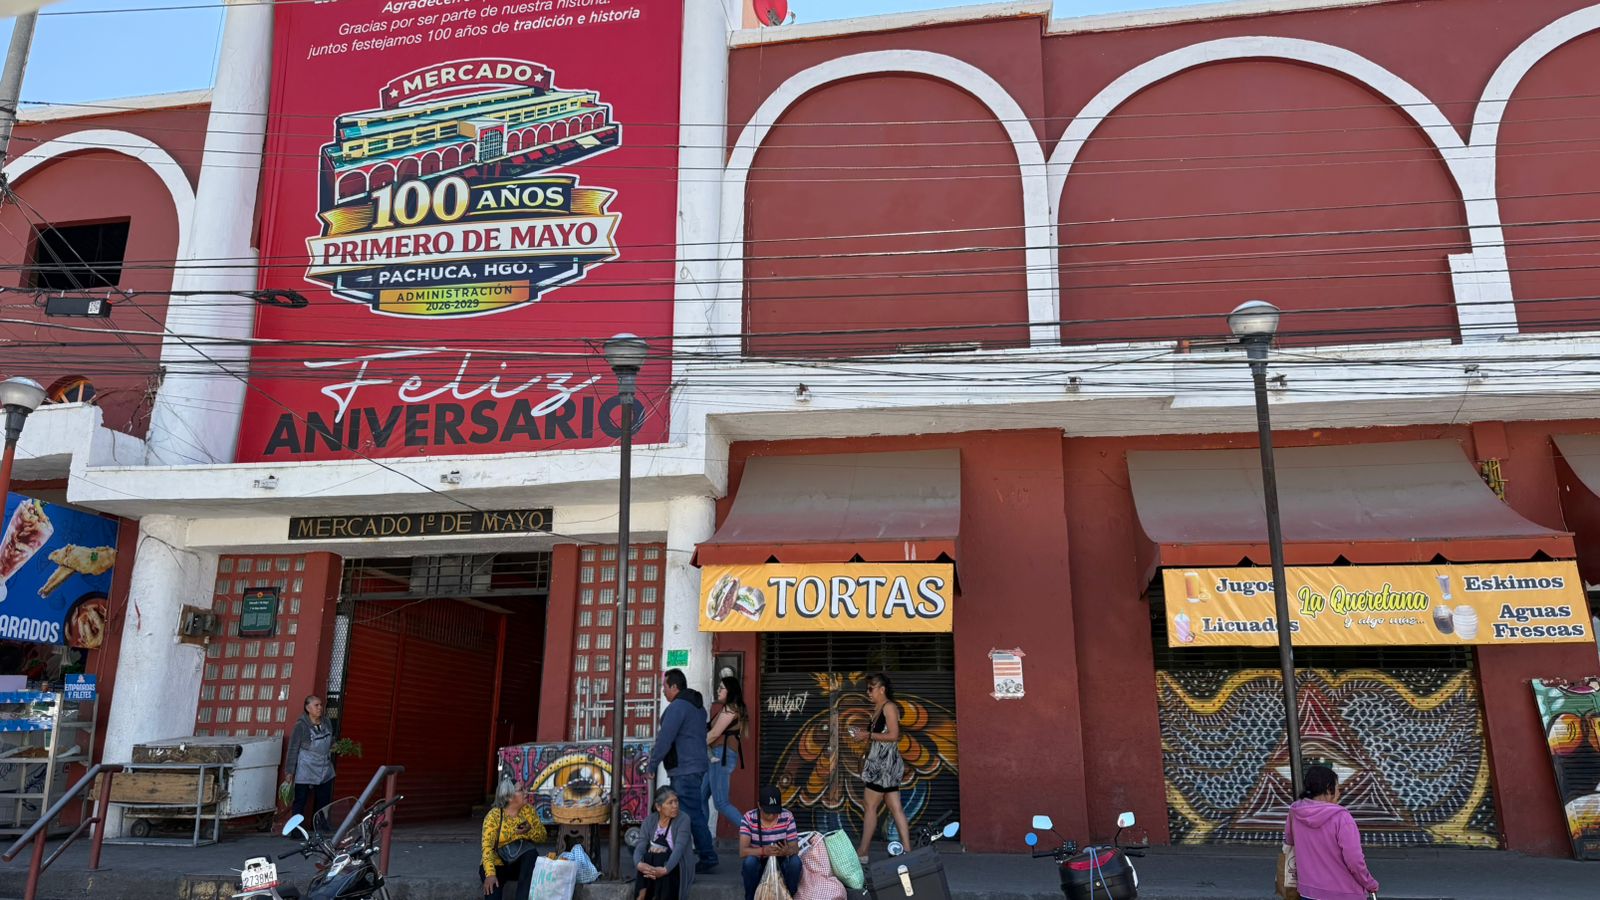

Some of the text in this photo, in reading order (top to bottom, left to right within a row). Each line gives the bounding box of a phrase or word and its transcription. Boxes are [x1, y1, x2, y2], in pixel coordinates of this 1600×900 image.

[338, 20, 387, 36] Gracias
[390, 17, 414, 32] por
[417, 14, 439, 26] ser
[440, 8, 477, 25] parte
[480, 5, 498, 17] de
[501, 0, 553, 15] nuestra
[307, 7, 641, 60] juntos festejamos 100 años de tradición e historia
[402, 63, 533, 95] MERCADO
[371, 176, 565, 229] 100 AÑOS
[323, 222, 598, 265] PRIMERO DE MAYO
[378, 262, 533, 285] PACHUCA, HGO.
[396, 282, 513, 302] ADMINISTRACIÓN
[425, 299, 480, 312] 2026-2029
[303, 347, 602, 424] Feliz
[263, 393, 646, 455] ANIVERSARIO
[297, 516, 411, 537] MERCADO
[440, 513, 473, 533] DE
[480, 511, 545, 532] MAYO
[1215, 578, 1276, 596] Jugos
[1464, 575, 1564, 591] Eskimos
[767, 574, 946, 619] TORTAS
[1298, 583, 1430, 618] La Queretana
[1202, 617, 1299, 632] Licuads
[1344, 616, 1353, 629] y
[1499, 604, 1571, 622] Aguas
[1493, 623, 1585, 638] Frescas
